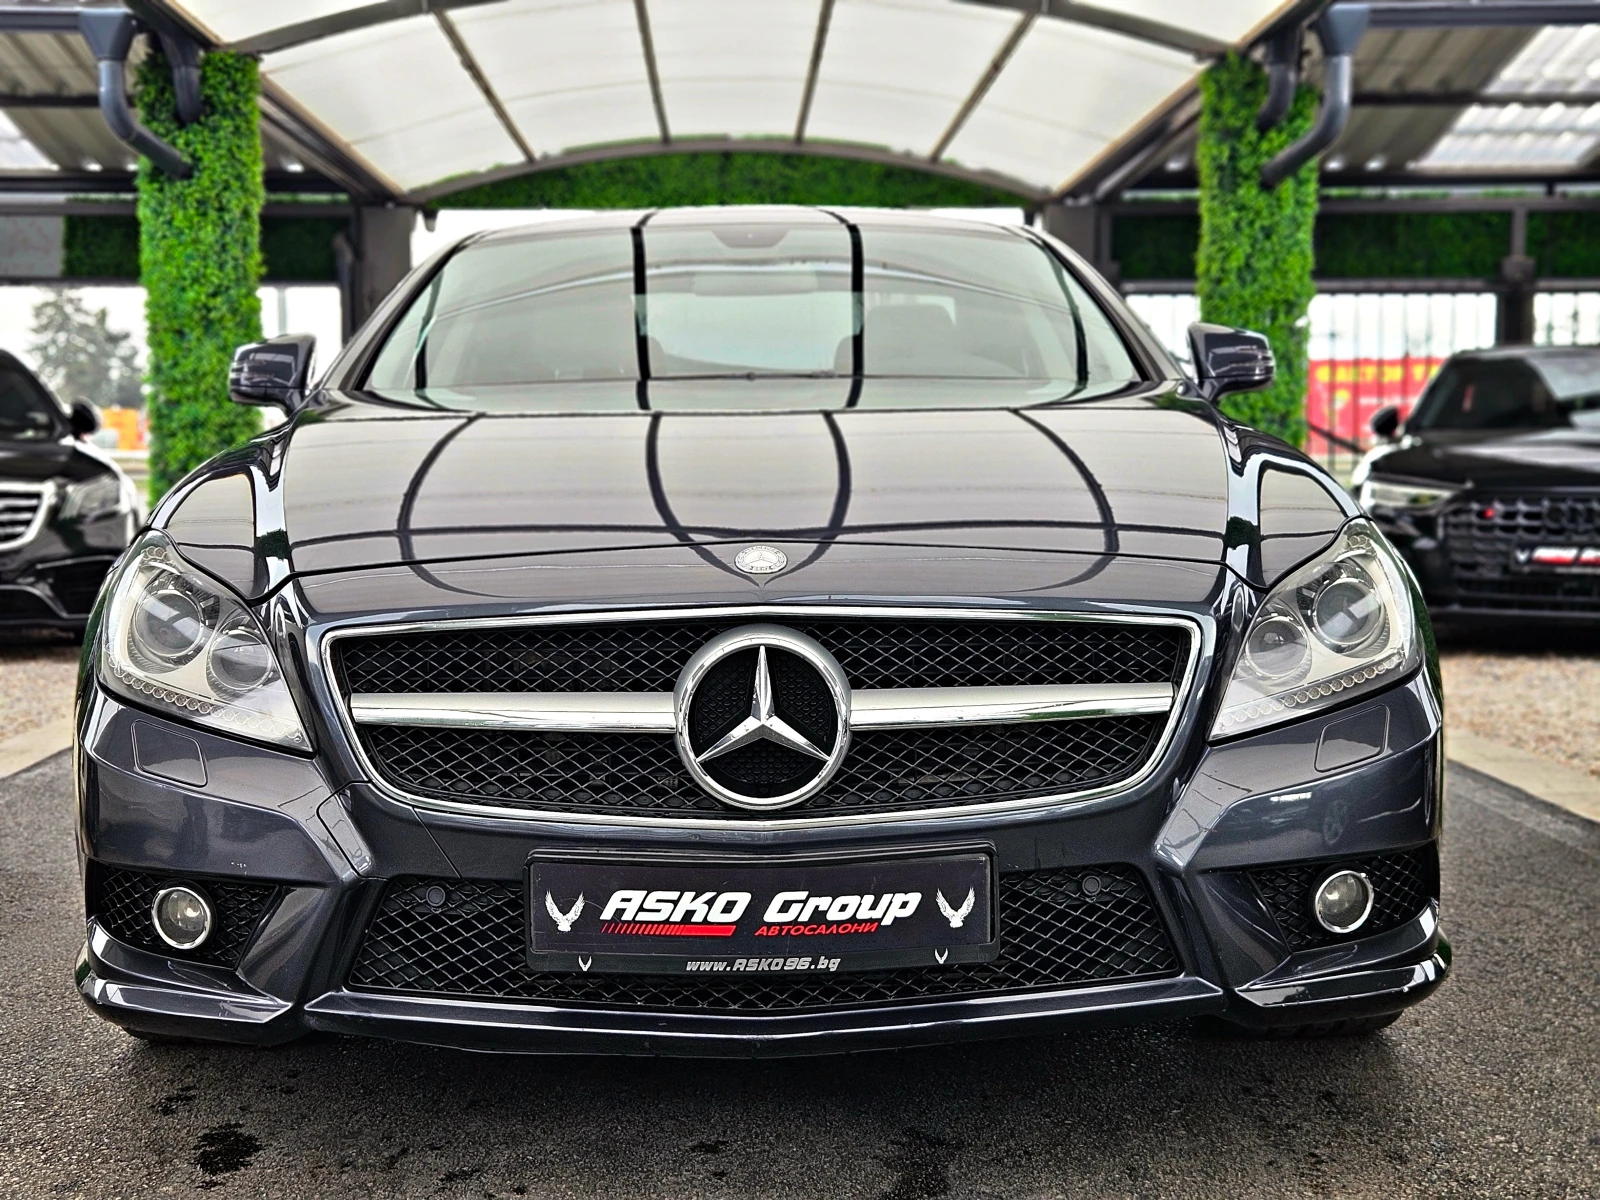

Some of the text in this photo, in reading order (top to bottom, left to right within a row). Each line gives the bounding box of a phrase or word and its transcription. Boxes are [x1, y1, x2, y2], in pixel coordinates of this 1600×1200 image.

[599, 889, 922, 926] ASKO Group
[754, 922, 879, 936] АВТОСАЛОНИ
[686, 956, 841, 972] www.ASKO96.bg
